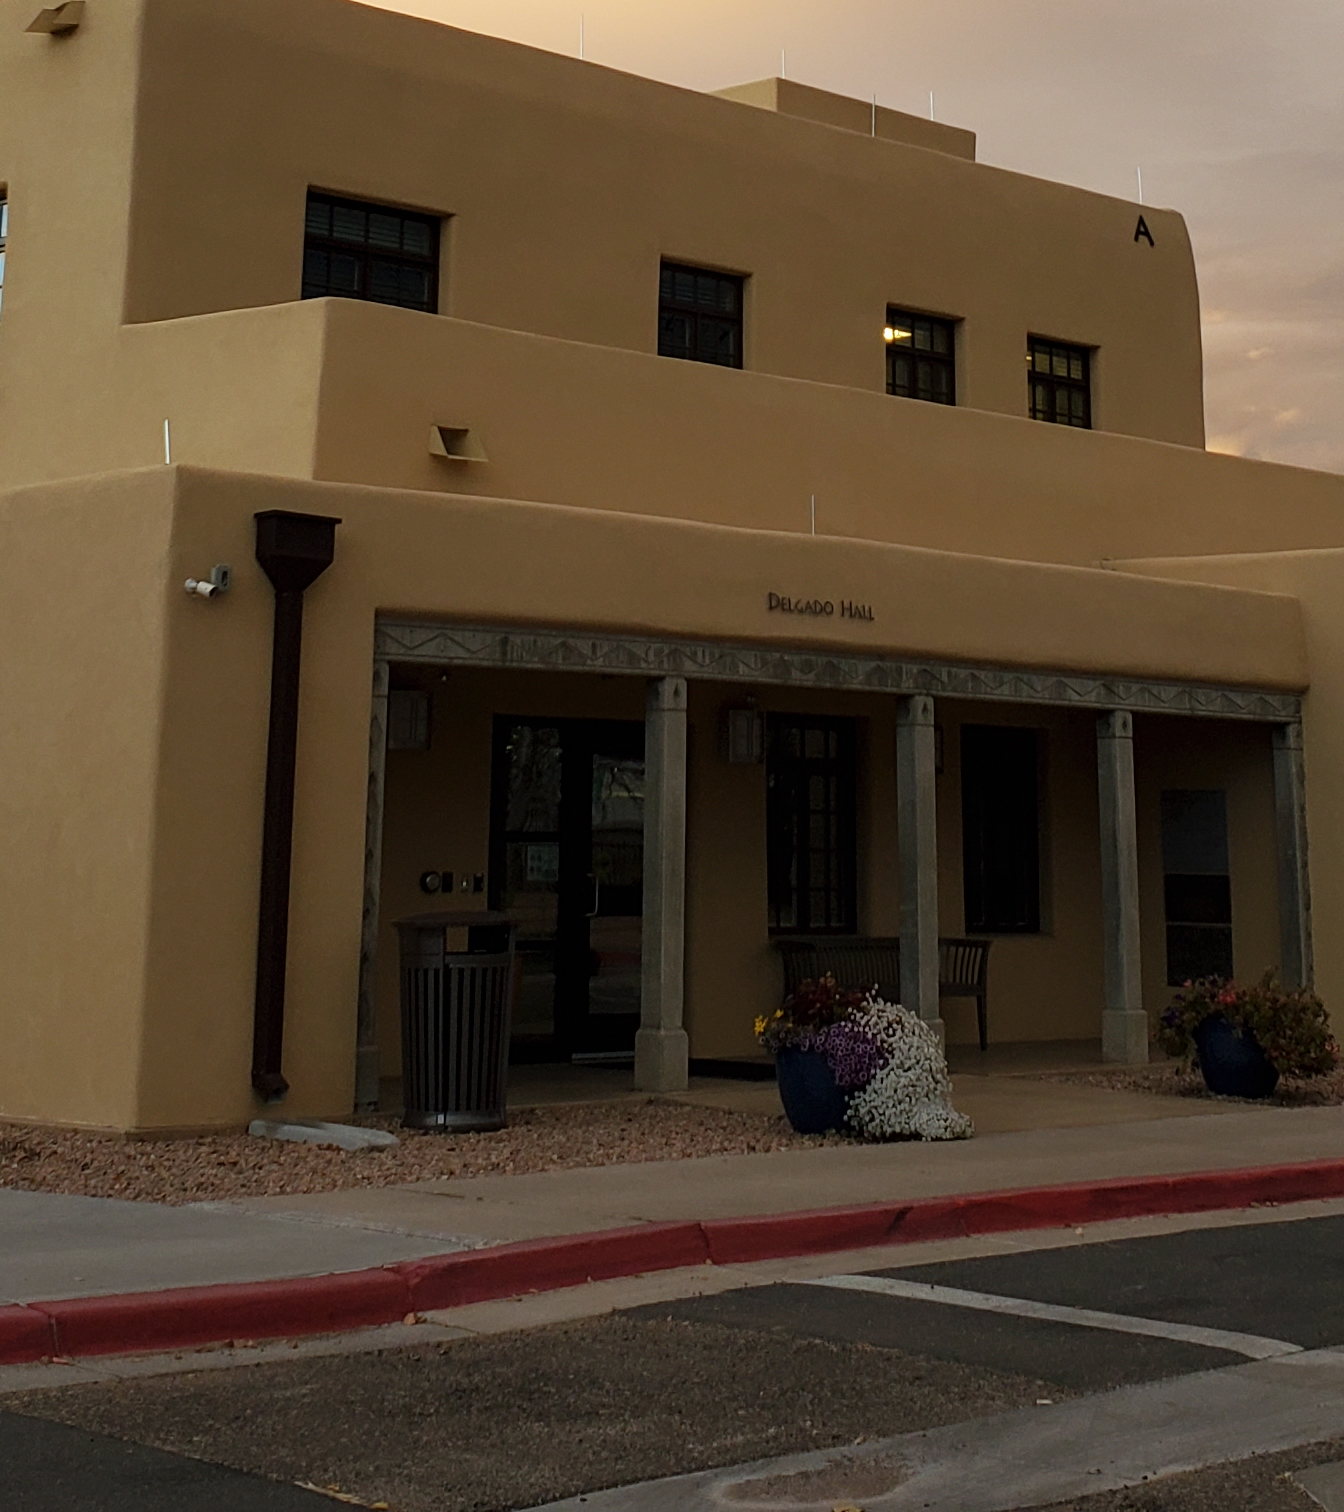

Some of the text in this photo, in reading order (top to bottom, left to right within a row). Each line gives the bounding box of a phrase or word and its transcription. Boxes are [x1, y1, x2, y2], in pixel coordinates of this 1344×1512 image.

[1134, 214, 1155, 248] A
[768, 591, 875, 621] DELGADO HALL
